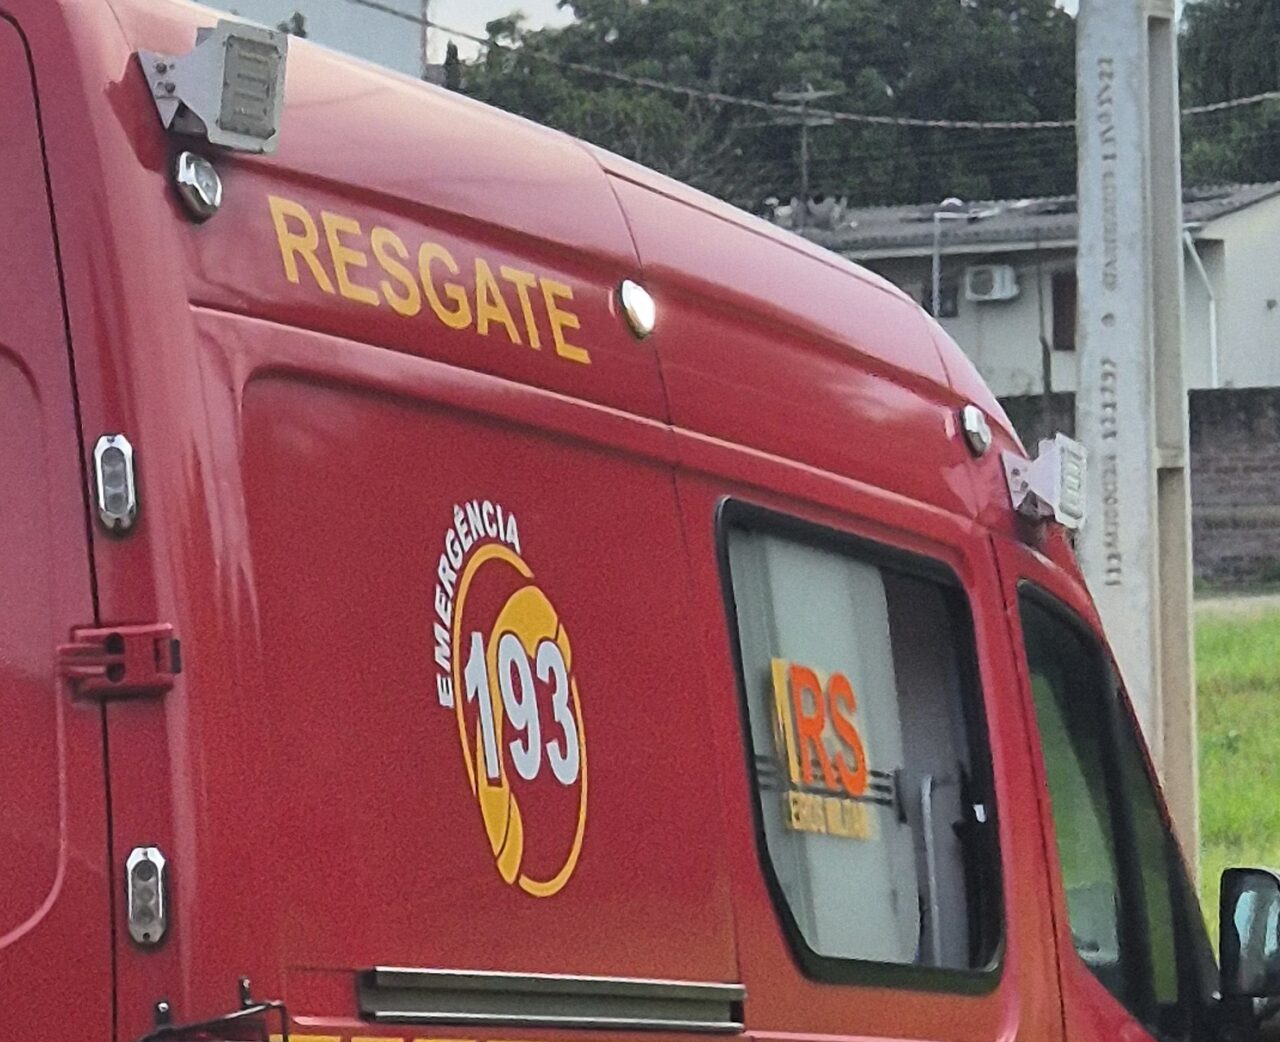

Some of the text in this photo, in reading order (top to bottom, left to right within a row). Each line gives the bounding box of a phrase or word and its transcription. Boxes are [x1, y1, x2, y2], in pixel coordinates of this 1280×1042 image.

[268, 195, 591, 365] RESGATE
[433, 499, 521, 709] EMERGÊNCIA
[464, 631, 581, 786] 193
